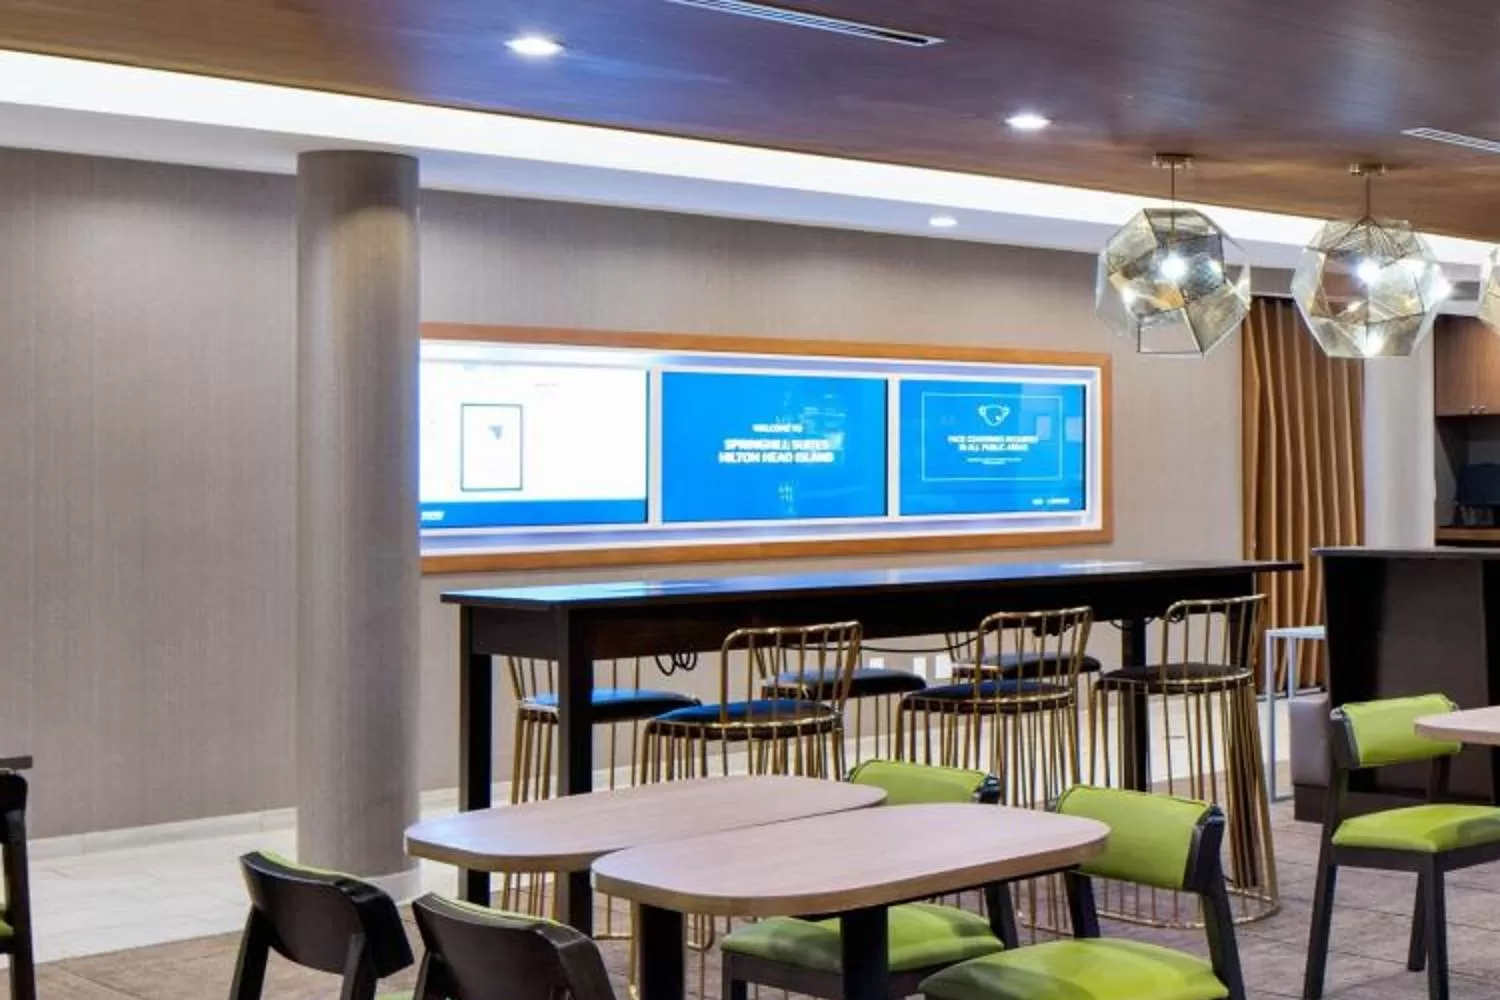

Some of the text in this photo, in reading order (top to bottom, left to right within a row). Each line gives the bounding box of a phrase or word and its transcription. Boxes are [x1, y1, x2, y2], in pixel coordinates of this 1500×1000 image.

[718, 451, 834, 463] HILTON HEAD ISLAND
